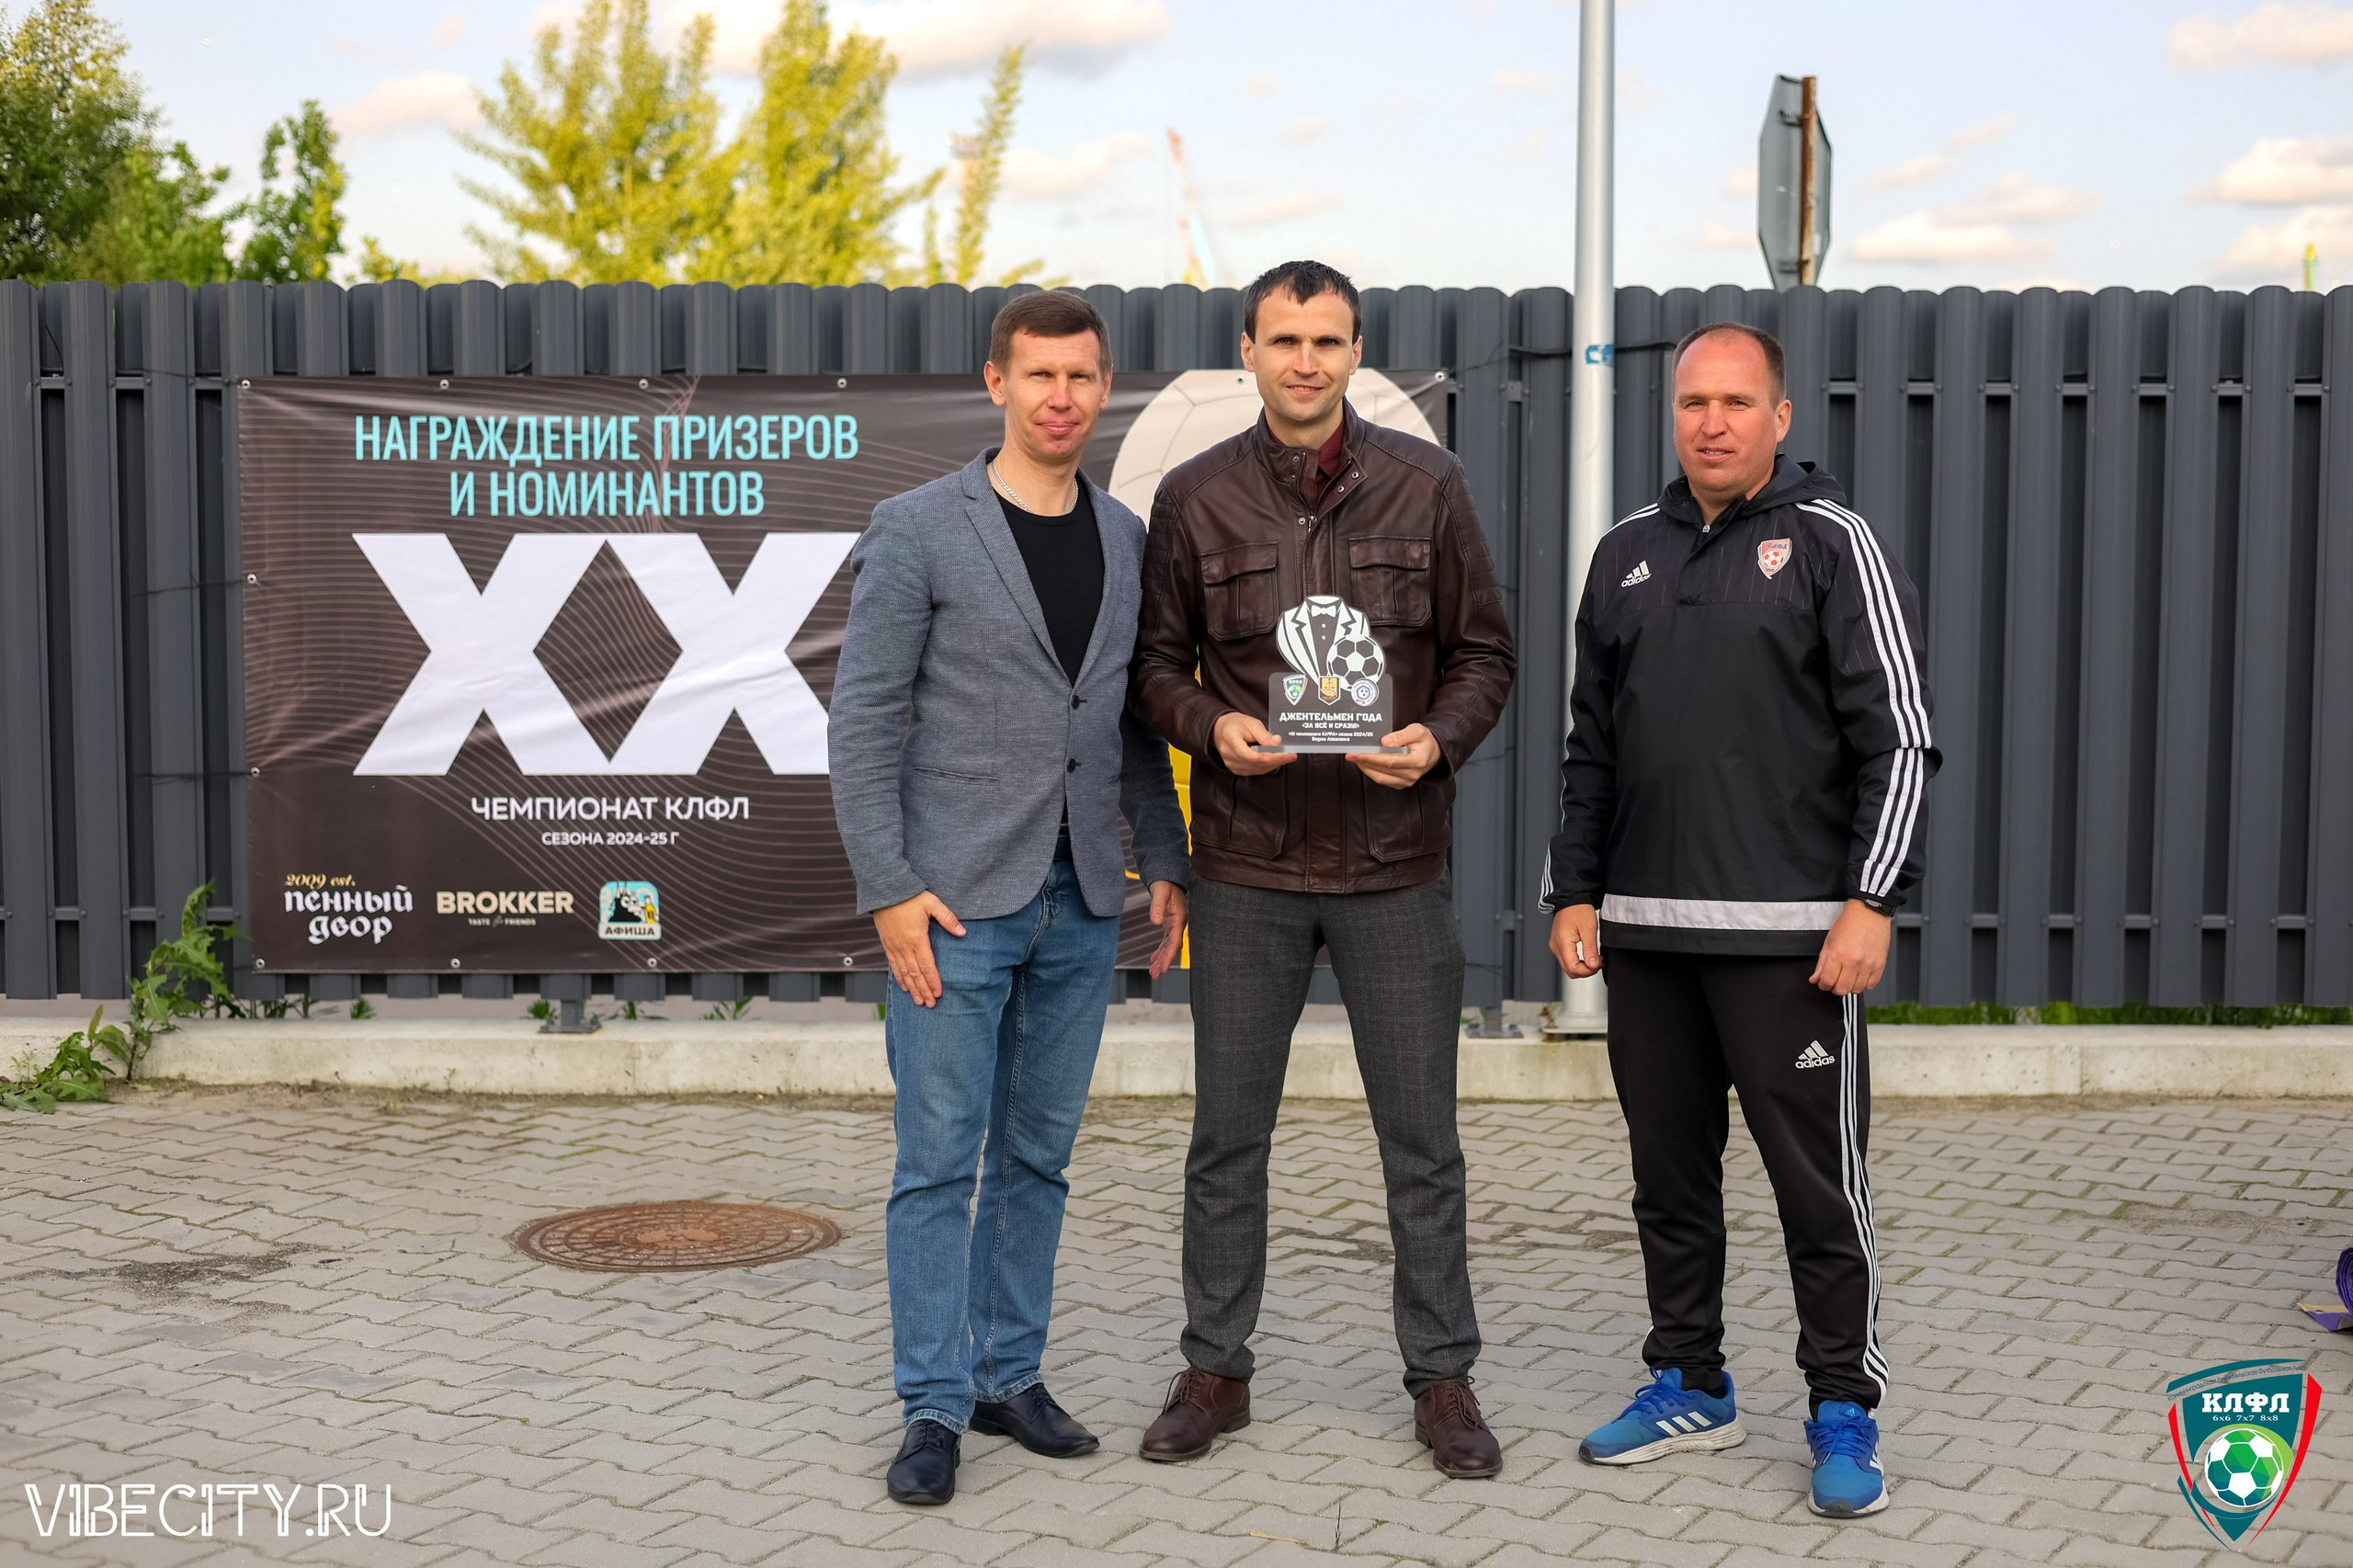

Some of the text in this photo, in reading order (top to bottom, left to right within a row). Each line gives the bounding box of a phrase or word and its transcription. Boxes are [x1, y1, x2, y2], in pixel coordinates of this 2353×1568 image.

[355, 414, 858, 467] НАГРАЖДЕНИЕ ПРИЗЕРОВ
[449, 471, 766, 517] И НОМИНАНТОВ
[1620, 574, 1652, 587] adidas
[1279, 712, 1382, 723] ДЖЕНТЕЛЬМЕН ГОДА
[472, 796, 750, 821] ЧЕМПИОНАТ КЛФЛ
[541, 832, 680, 846] СЕЗОНА 2024-25 Г
[284, 873, 327, 891] 2009
[437, 891, 574, 915] BROKKER
[468, 918, 491, 926] TASTE
[505, 918, 537, 926] FRIENDS
[605, 926, 655, 936] АФИША
[1795, 1055, 1836, 1069] adidas
